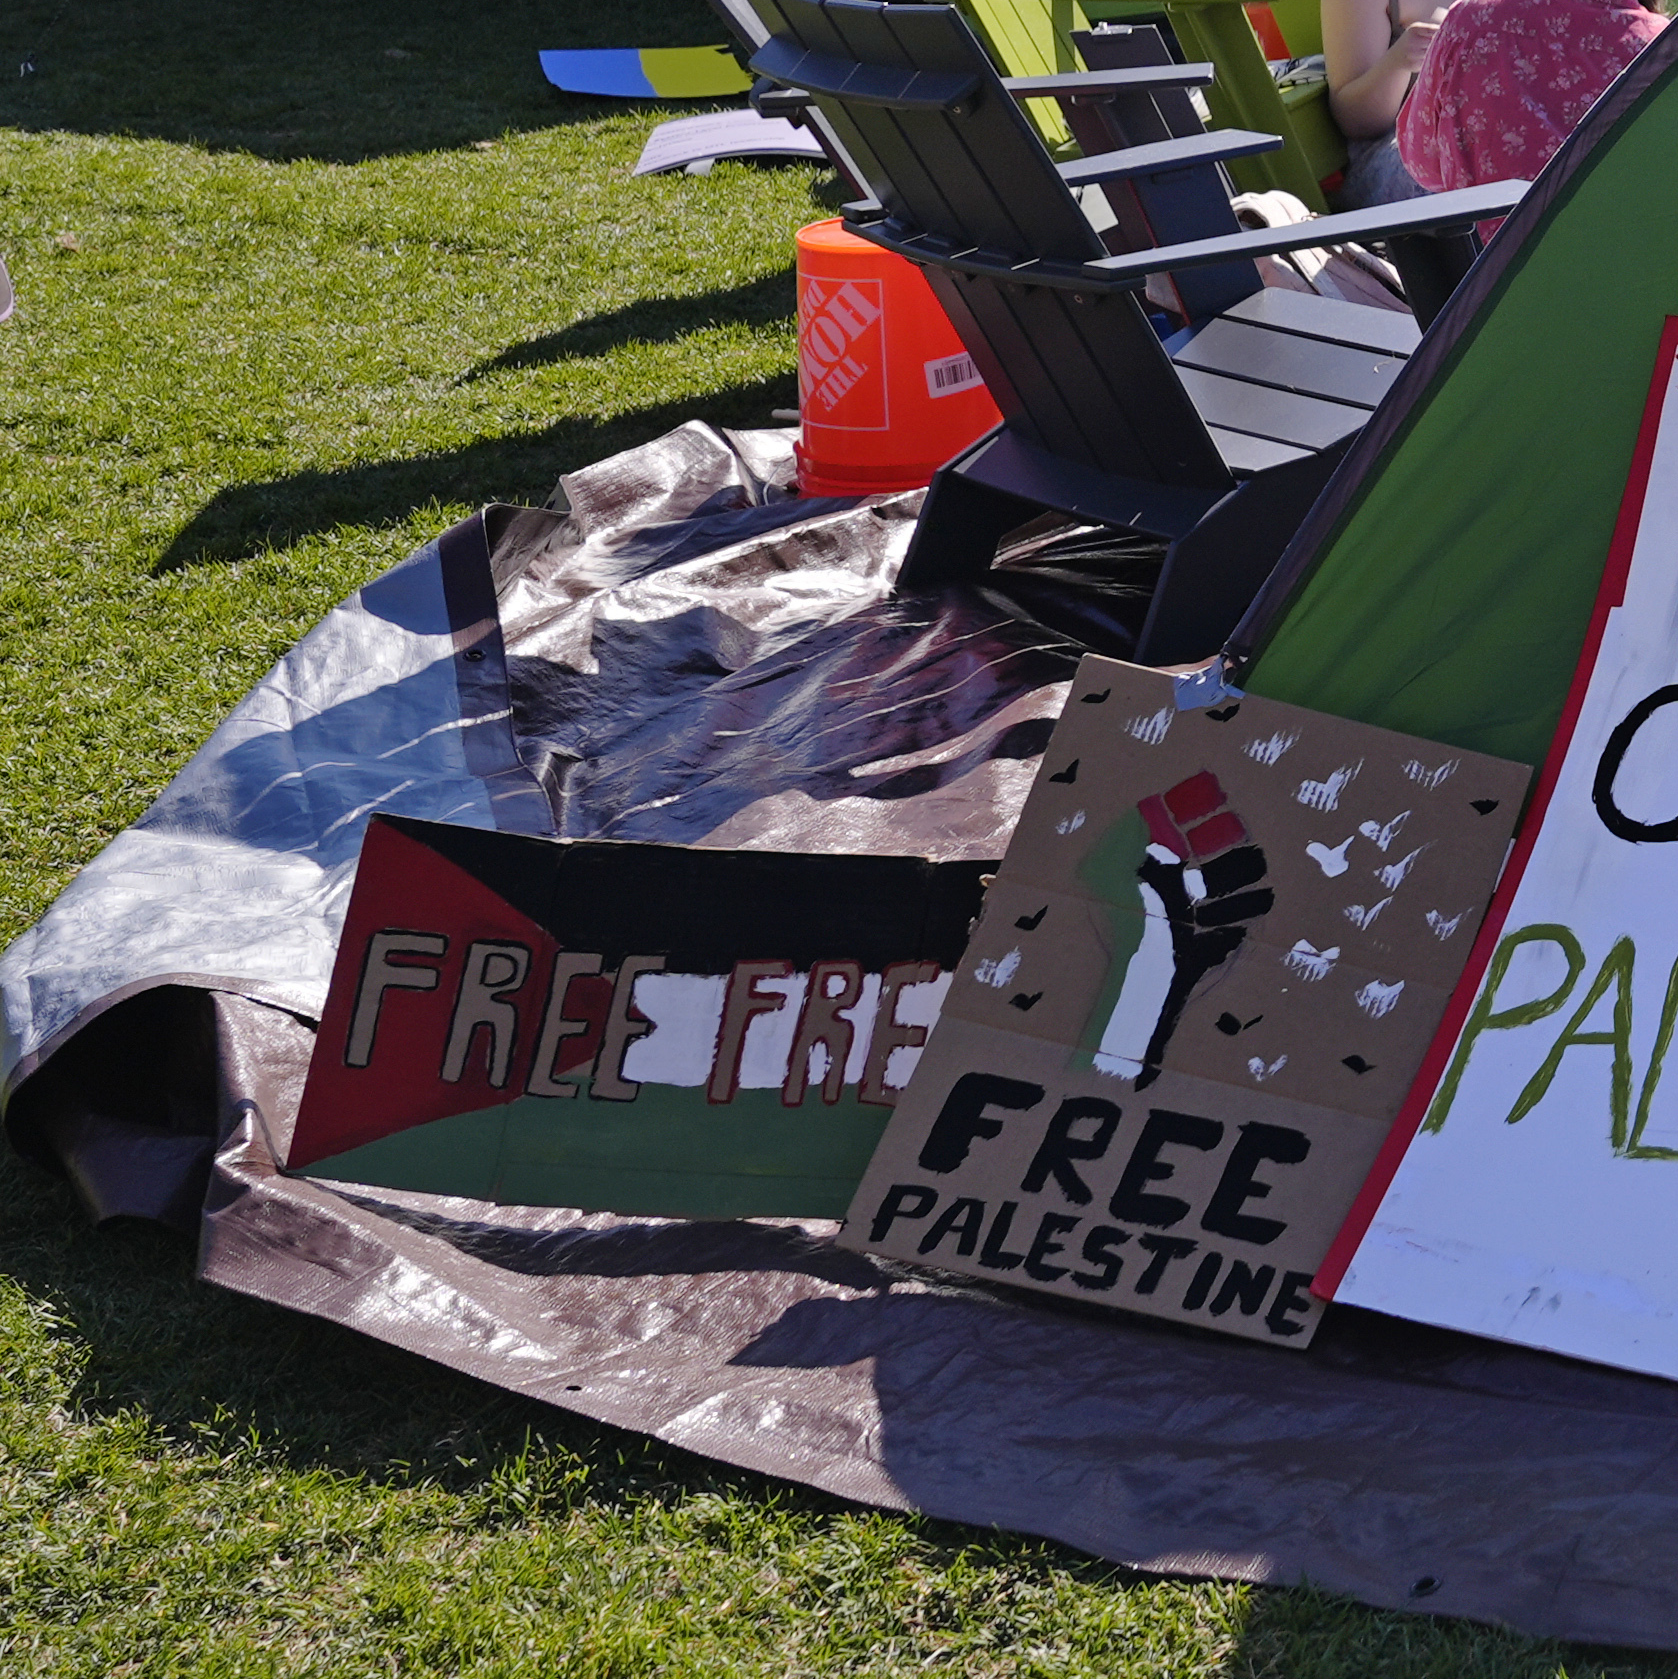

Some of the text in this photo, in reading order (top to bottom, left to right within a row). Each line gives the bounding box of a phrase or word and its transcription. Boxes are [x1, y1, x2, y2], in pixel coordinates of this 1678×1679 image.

[815, 356, 868, 412] THE
[343, 927, 941, 1108] FREE FRE
[918, 1071, 1312, 1245] FREE
[869, 1183, 1314, 1336] PALESTINE
